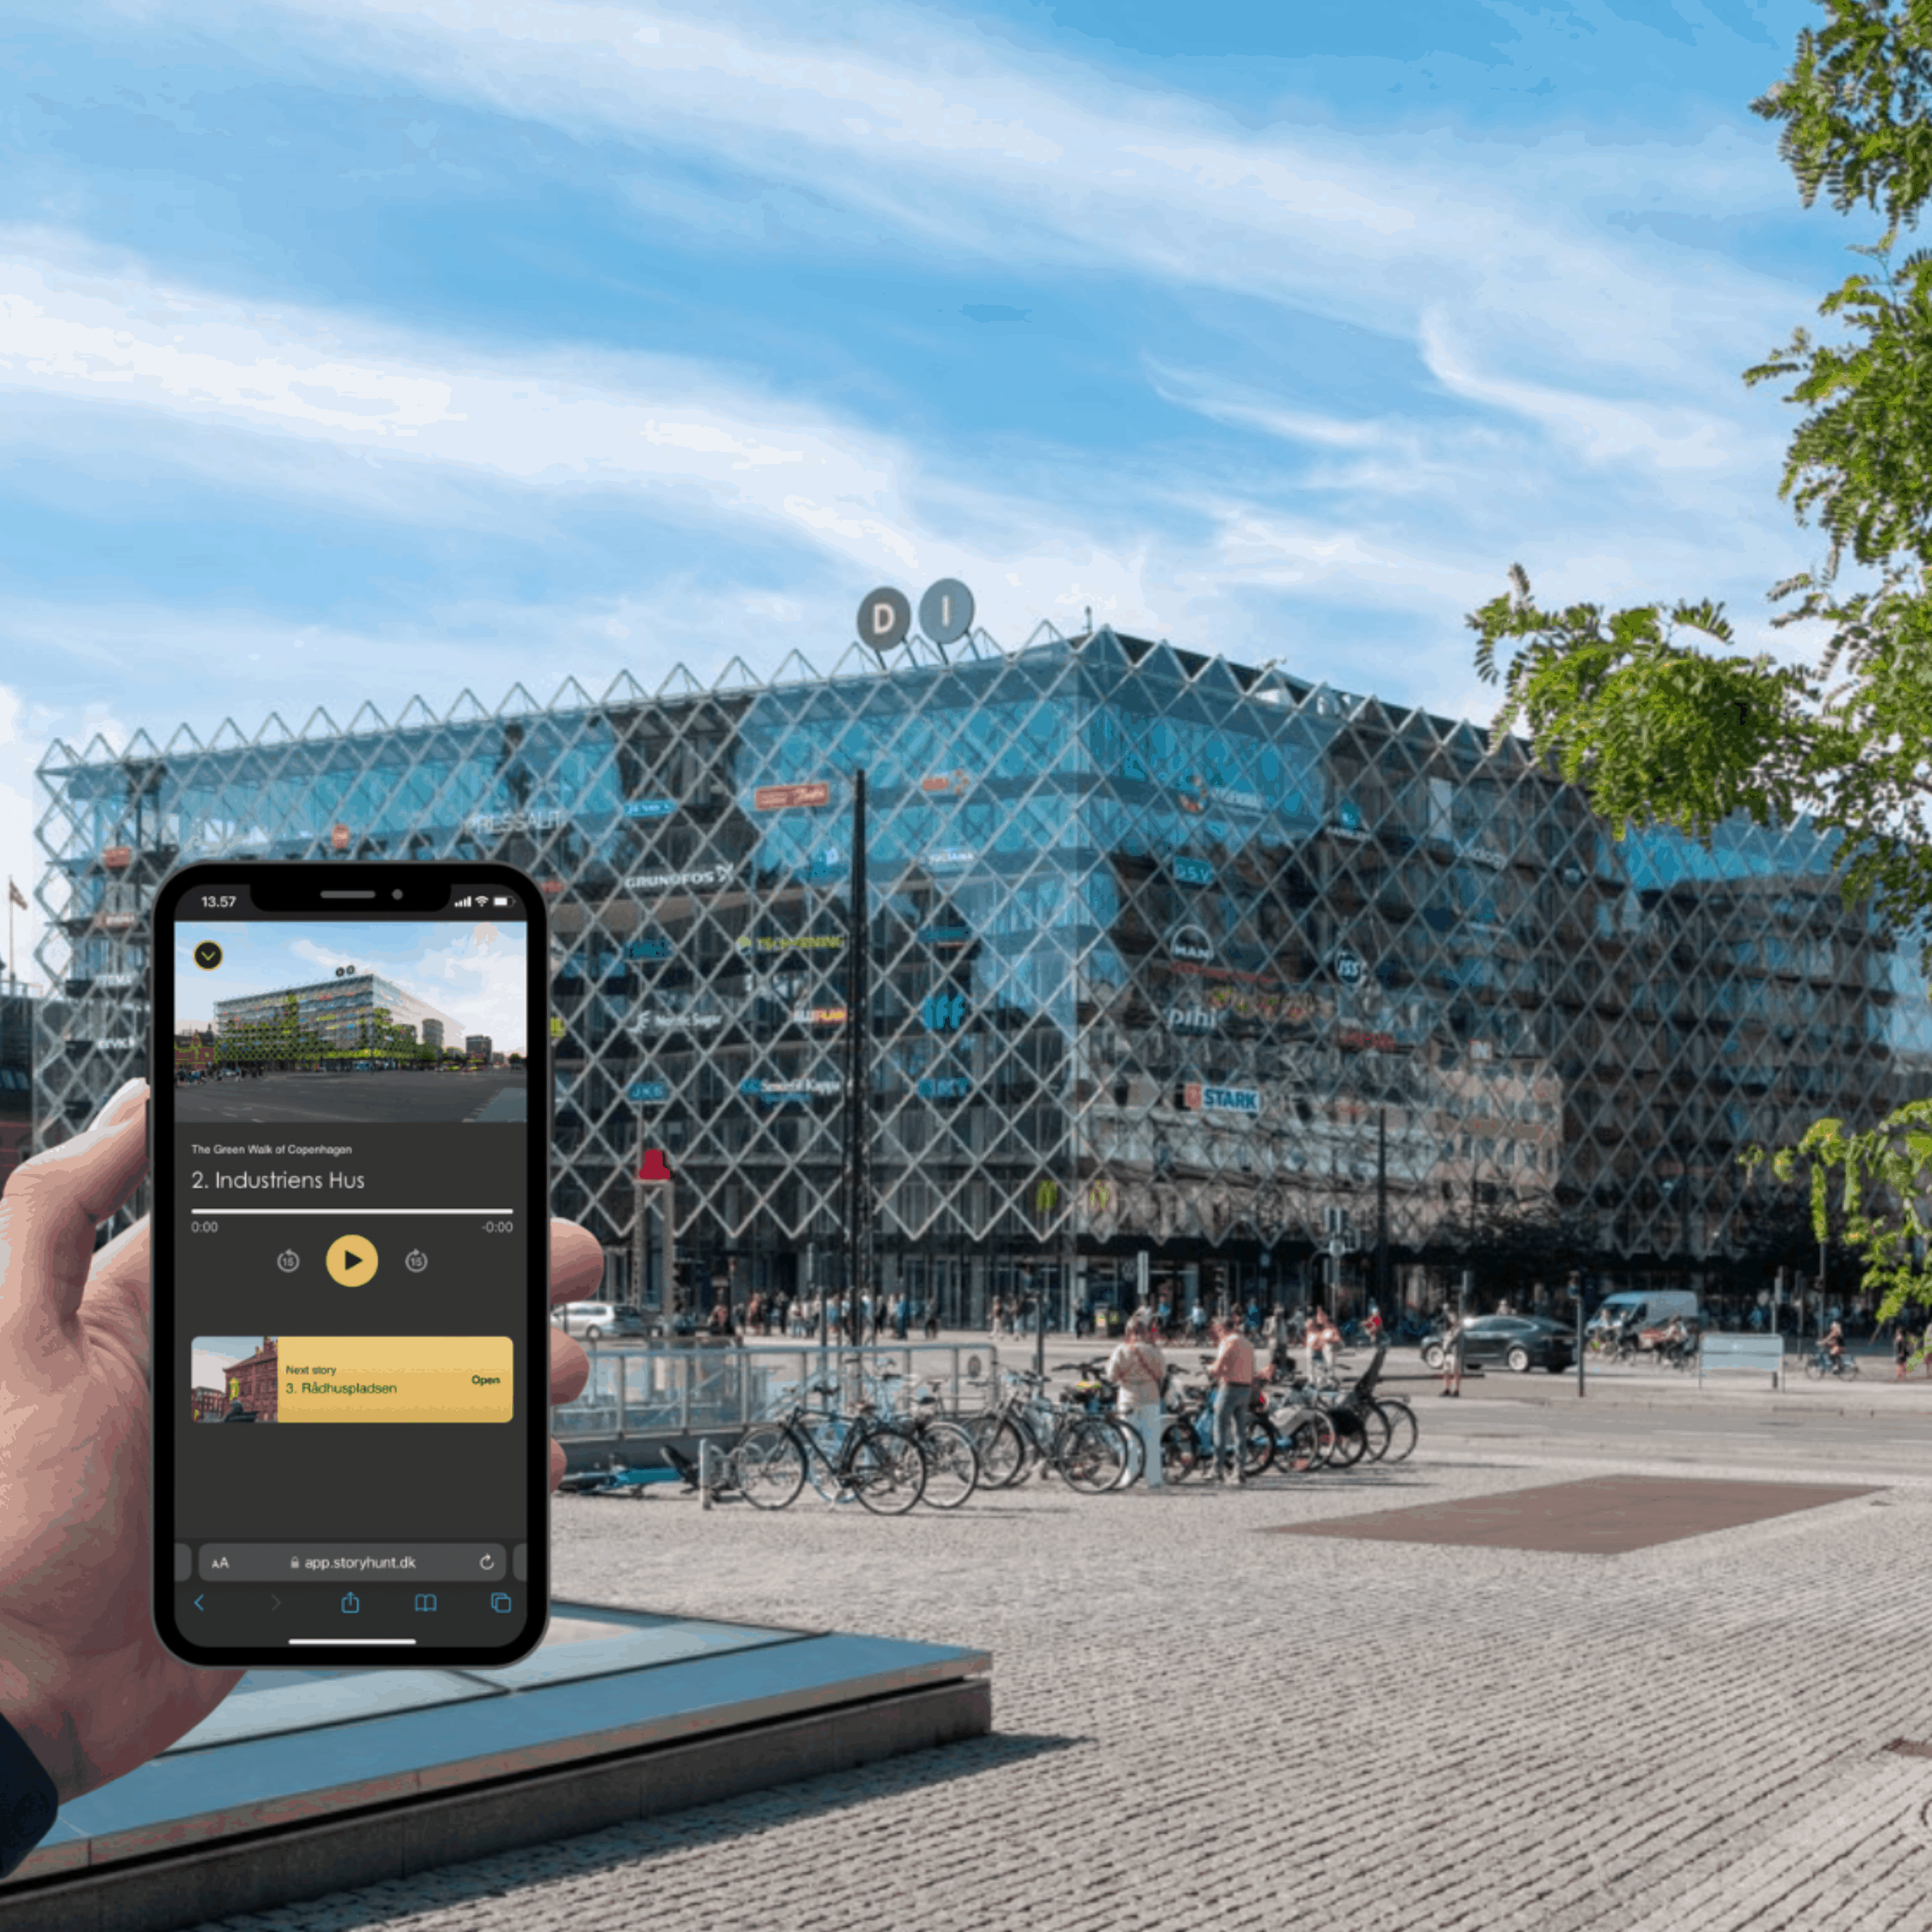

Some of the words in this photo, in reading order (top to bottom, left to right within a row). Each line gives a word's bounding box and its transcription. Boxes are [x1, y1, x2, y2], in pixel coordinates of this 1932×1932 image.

[202, 896, 237, 908] 13.57
[1204, 1089, 1258, 1109] STARK
[192, 1144, 211, 1154] The
[213, 1144, 245, 1154] Green
[248, 1144, 272, 1154] Walk
[276, 1144, 285, 1154] of
[287, 1144, 352, 1157] Copenhagen
[192, 1171, 209, 1189] 2.
[216, 1171, 323, 1189] Industriens
[330, 1171, 365, 1189] Hus
[191, 1221, 218, 1233] 0:00
[286, 1365, 309, 1375] Next
[312, 1366, 337, 1377] story
[471, 1374, 501, 1387] Open
[286, 1383, 298, 1394] 3.
[301, 1381, 397, 1396] Rådhuspladsen
[305, 1557, 416, 1571] app.storyhunt.dk
